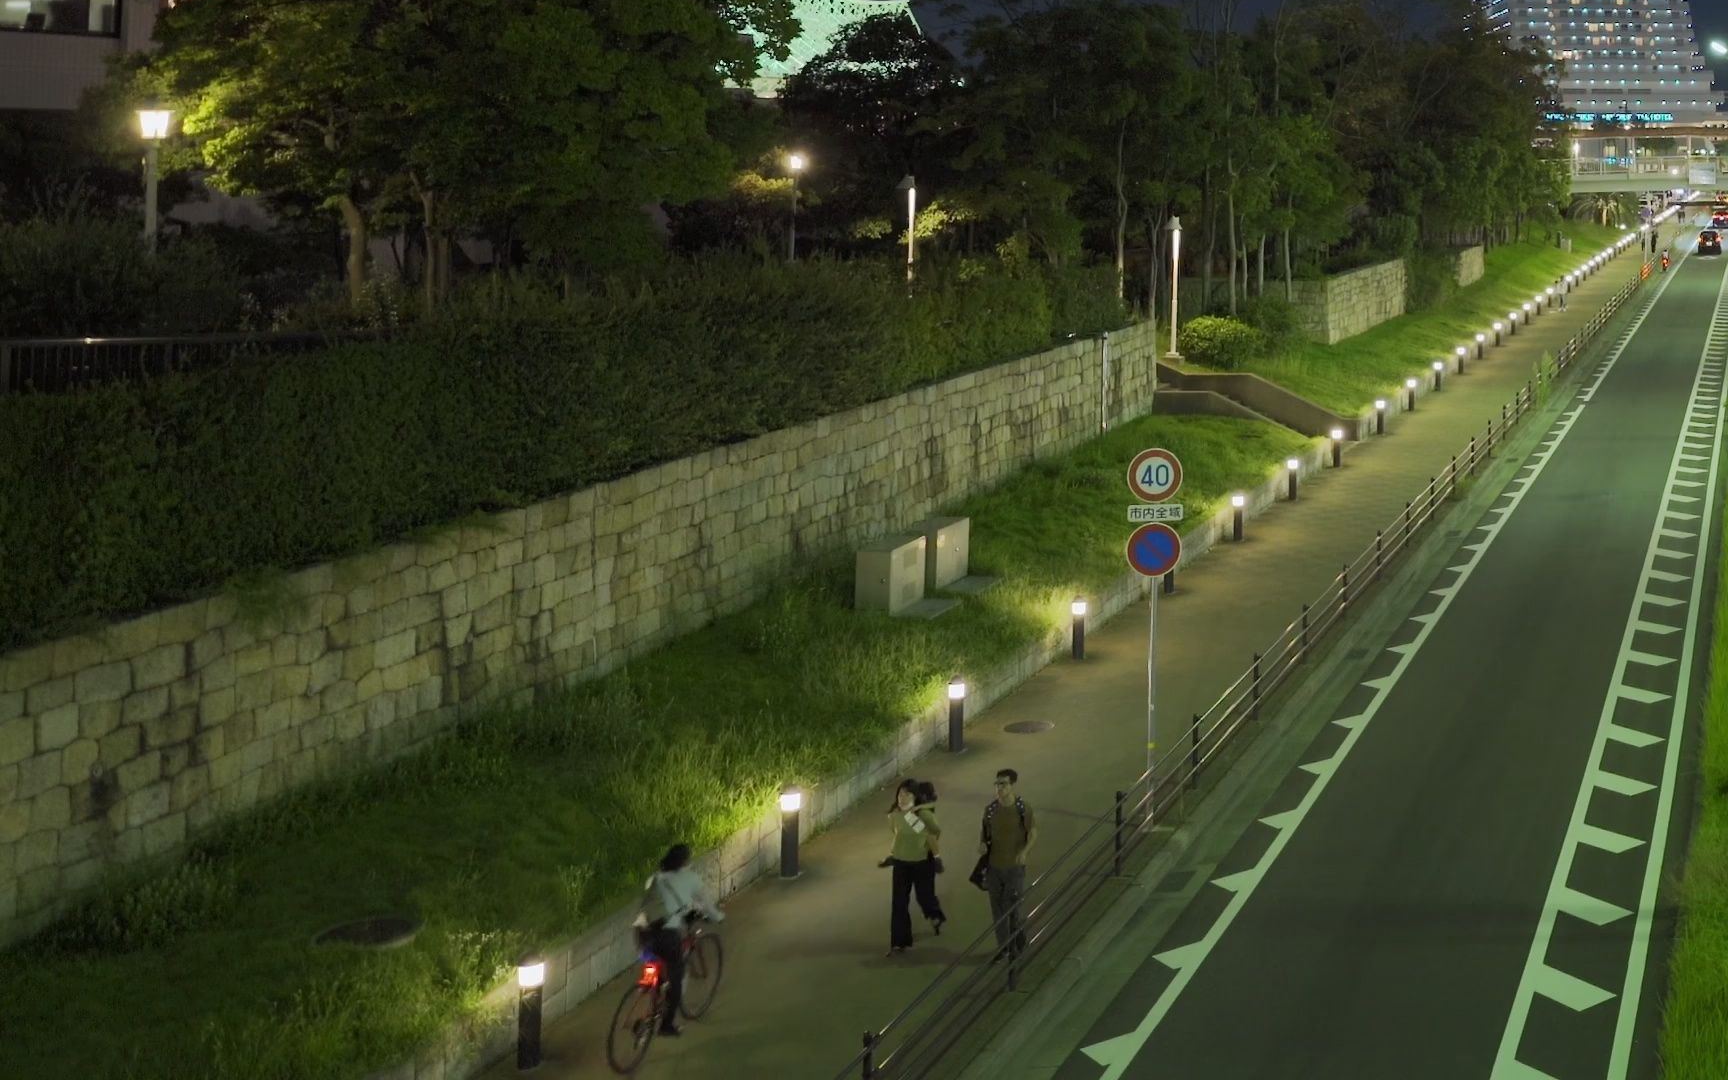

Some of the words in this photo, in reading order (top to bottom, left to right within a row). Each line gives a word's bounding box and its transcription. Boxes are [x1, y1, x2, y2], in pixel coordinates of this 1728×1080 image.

[1140, 464, 1170, 487] 40
[1130, 507, 1181, 519] 市内全域
